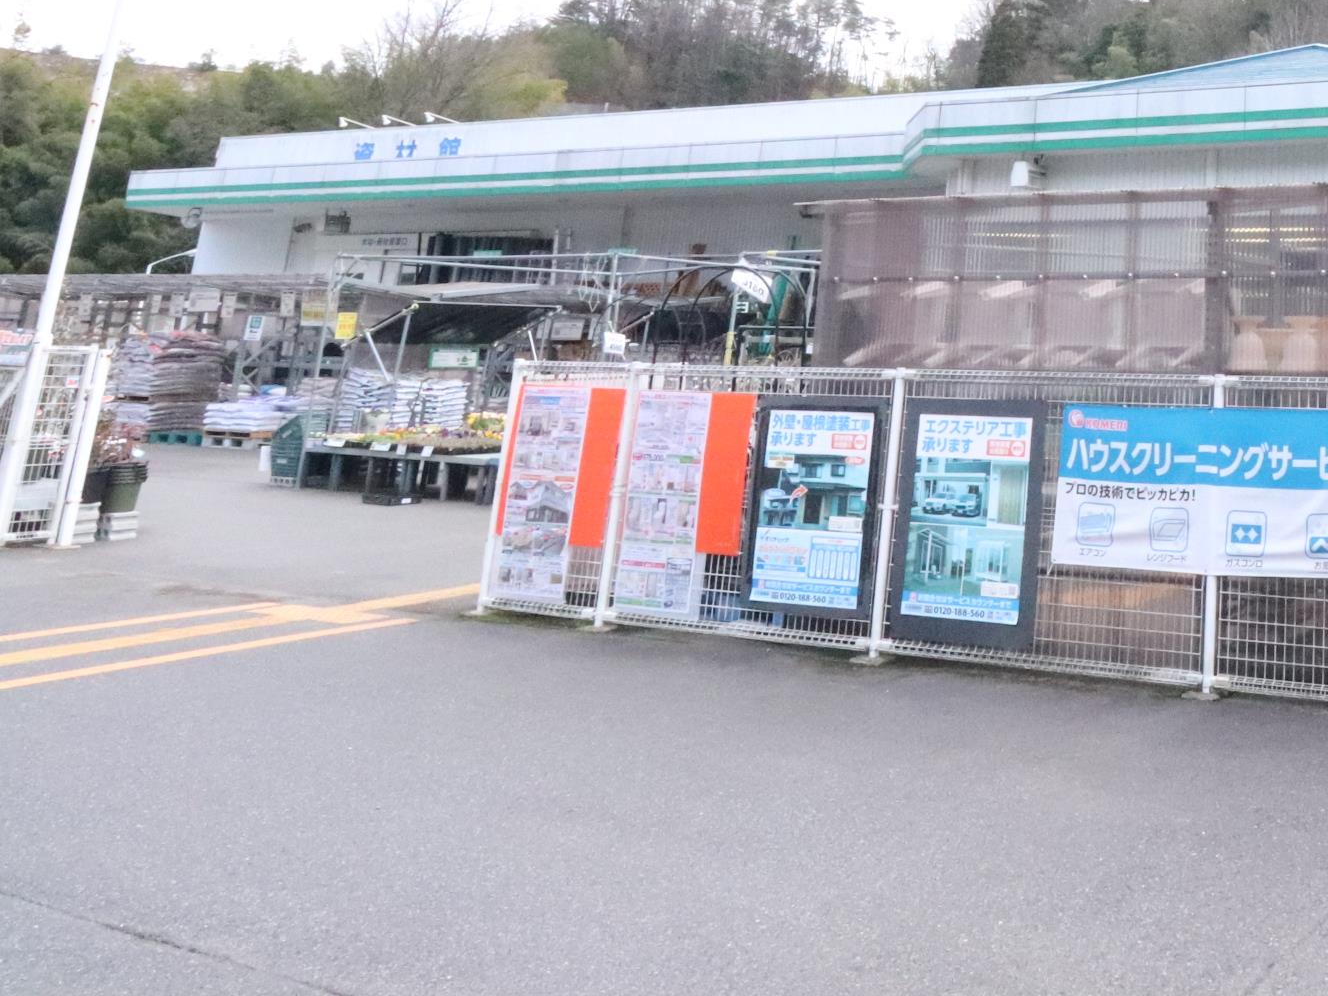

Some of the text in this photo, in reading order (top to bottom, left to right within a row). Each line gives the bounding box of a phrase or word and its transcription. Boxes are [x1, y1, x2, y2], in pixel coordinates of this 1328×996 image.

[924, 419, 1027, 439] エクステリア工事
[770, 431, 817, 447] 承ります
[922, 436, 974, 454] 承ります
[779, 591, 827, 604] 0120-188-560
[933, 605, 985, 619] 0120-188-560
